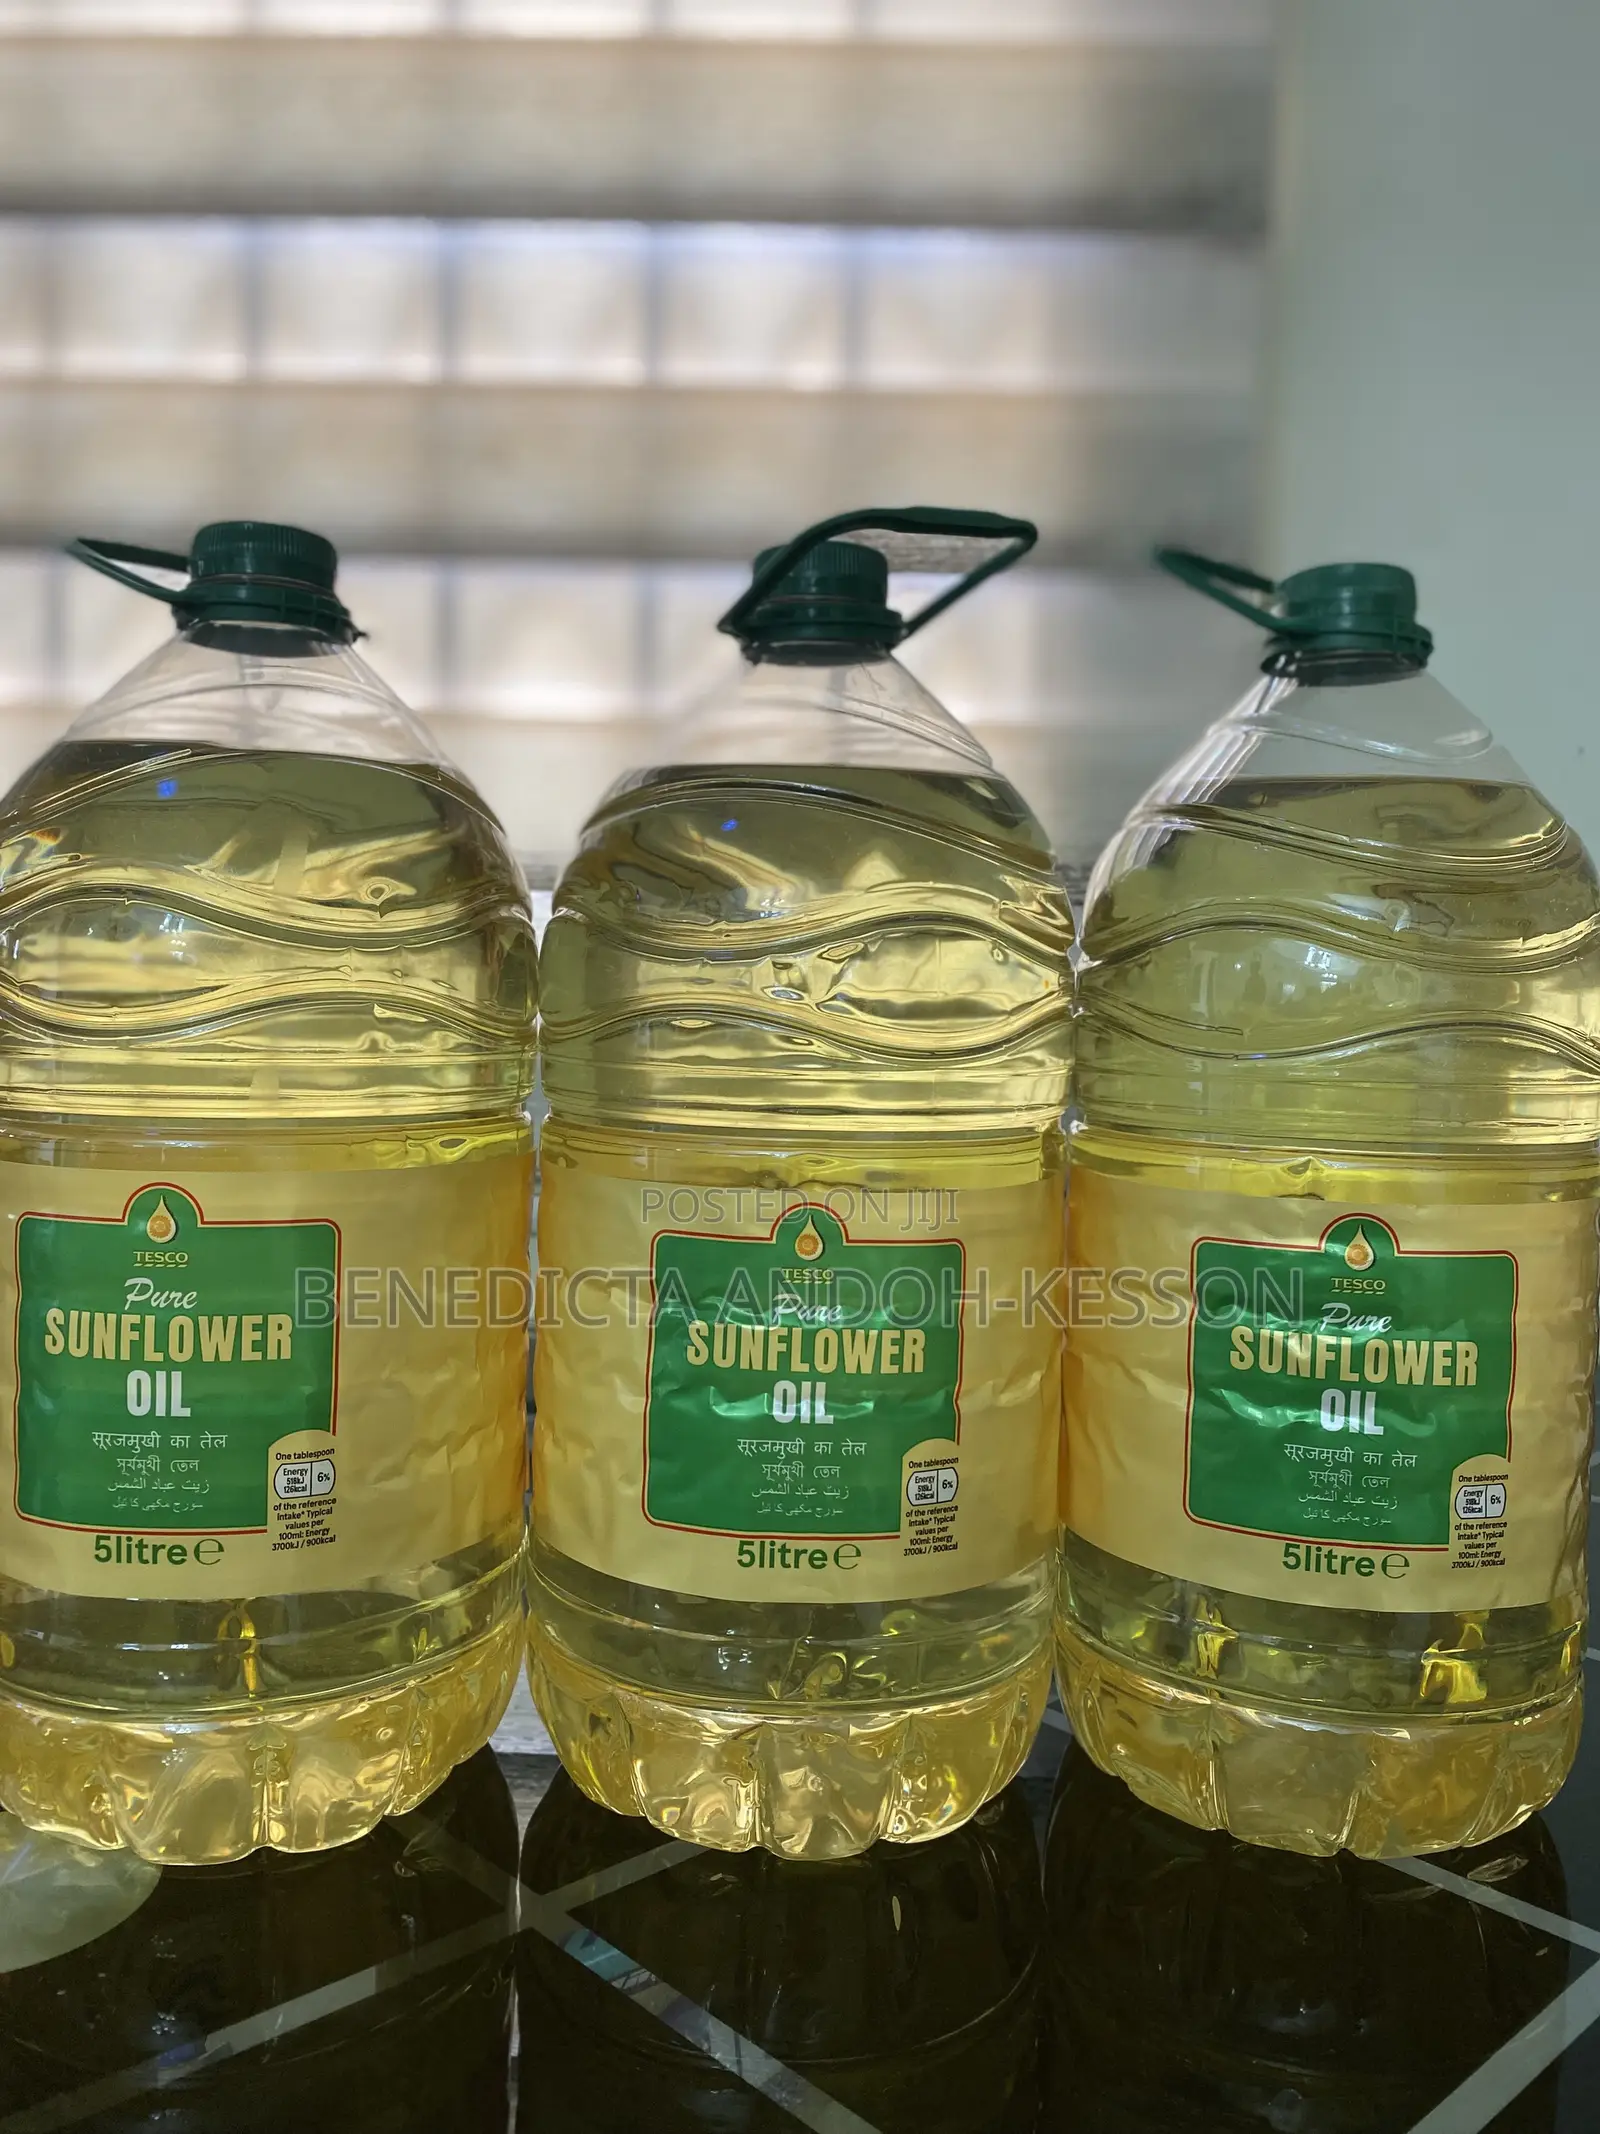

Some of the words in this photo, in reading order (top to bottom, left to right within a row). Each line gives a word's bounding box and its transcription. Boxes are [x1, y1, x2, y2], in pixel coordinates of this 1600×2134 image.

[133, 1251, 188, 1263] TESCO
[782, 1269, 834, 1279] TESCO
[1331, 1278, 1386, 1290] TESCO
[124, 1277, 197, 1310] Pure
[773, 1294, 842, 1323] Pure
[1320, 1302, 1392, 1332] Pure
[45, 1308, 293, 1362] SUNFLOWER
[686, 1319, 926, 1374] SUNFLOWER
[1229, 1325, 1479, 1387] SUNFLOWER
[127, 1370, 191, 1417] OIL
[772, 1380, 834, 1425] OIL
[1320, 1389, 1384, 1436] OIL
[92, 1431, 161, 1453] सूरजमुखी
[170, 1435, 191, 1448] का
[200, 1431, 228, 1449] तेल
[294, 1448, 335, 1459] tablespoon
[737, 1438, 805, 1459] सूरजमुखी
[814, 1442, 833, 1454] का
[841, 1438, 867, 1456] तेल
[1284, 1444, 1354, 1466] सूरजमुखी
[1363, 1452, 1383, 1465] का
[1391, 1450, 1418, 1467] तेल
[924, 1457, 958, 1467] tablespoon
[283, 1468, 308, 1476] Energy
[317, 1472, 330, 1482] 6%
[915, 1476, 935, 1484] Energy
[942, 1479, 953, 1489] 6%
[274, 1503, 282, 1511] of
[283, 1502, 296, 1510] the
[299, 1498, 336, 1508] reference
[927, 1505, 958, 1515] reference
[307, 1507, 332, 1519] Typical
[285, 1521, 309, 1530] values
[311, 1519, 324, 1529] per
[934, 1514, 955, 1525] Typical
[1476, 1521, 1507, 1529] reference
[306, 1527, 330, 1537] Energy
[915, 1527, 936, 1536] values
[937, 1526, 949, 1535] per
[272, 1542, 299, 1551] 3700kJ
[307, 1535, 336, 1547] 900kcal
[933, 1534, 953, 1543] Energy
[94, 1535, 187, 1565] 5litre
[1464, 1542, 1484, 1550] values
[1486, 1541, 1497, 1550] per
[737, 1541, 828, 1569] 5litre
[1282, 1542, 1375, 1578] 5litre
[1481, 1550, 1501, 1558] Energy
